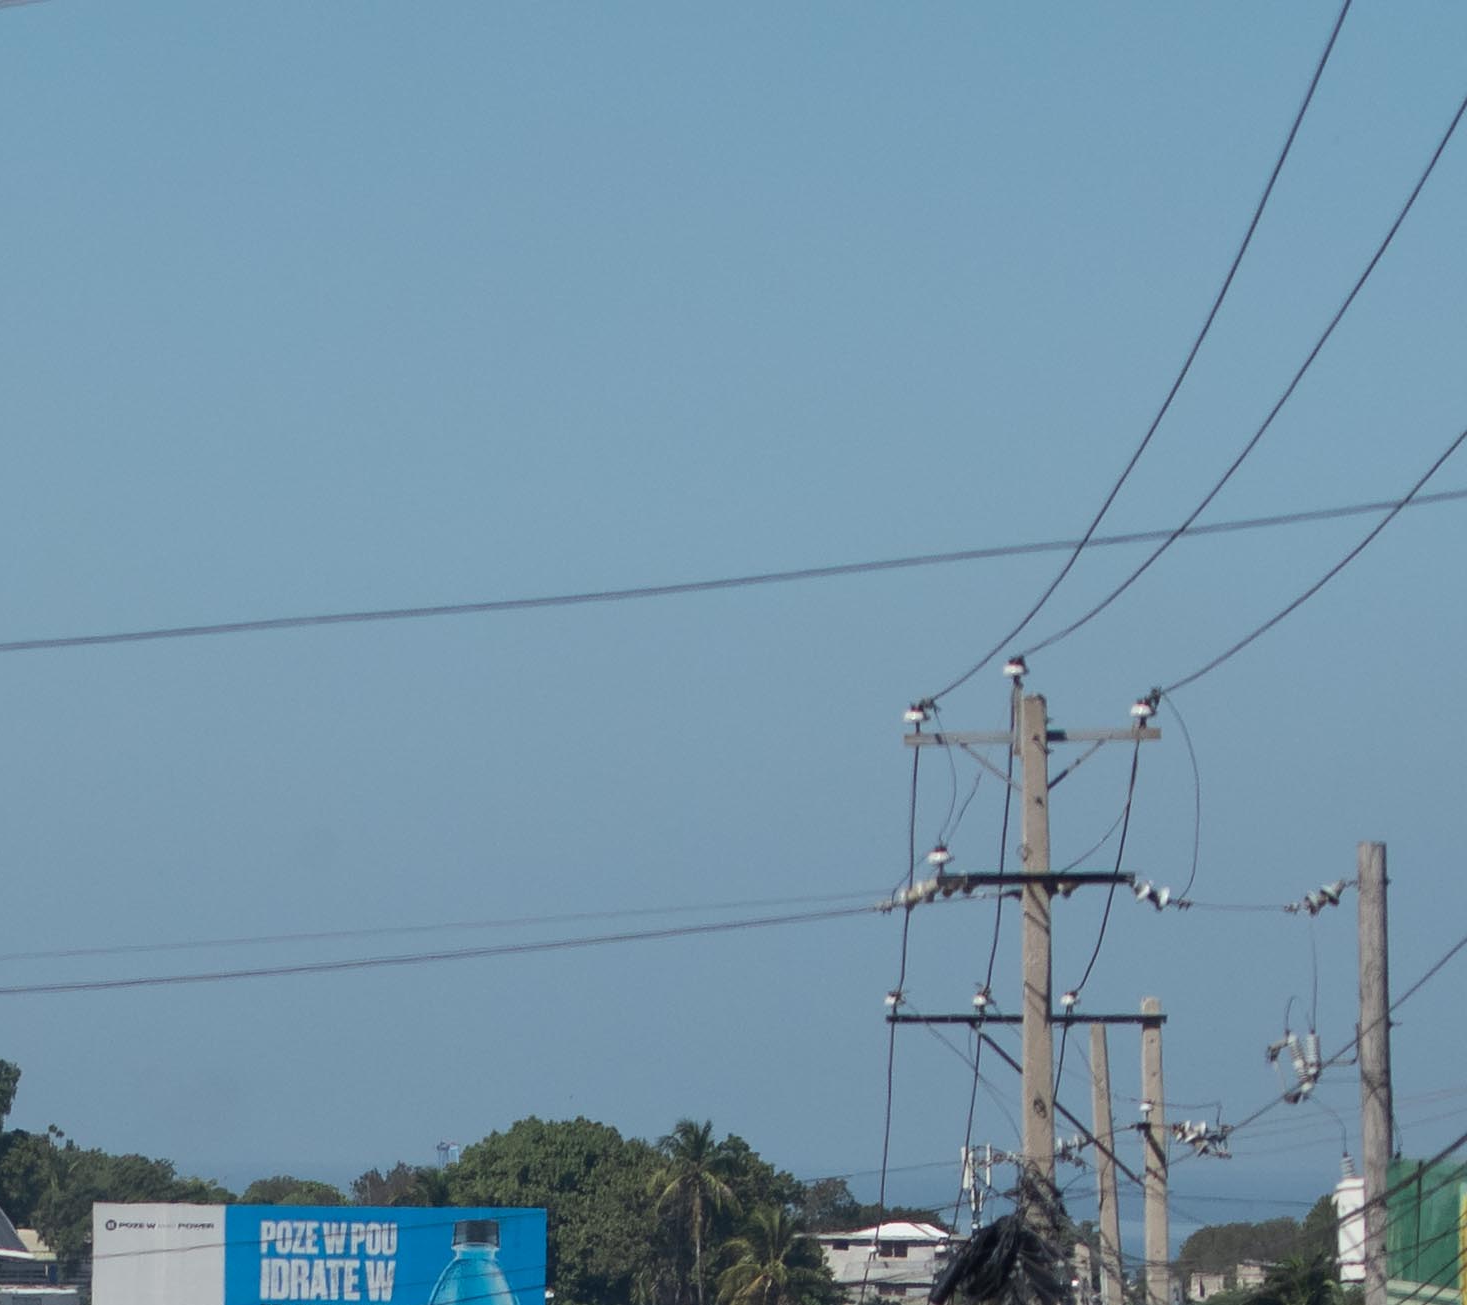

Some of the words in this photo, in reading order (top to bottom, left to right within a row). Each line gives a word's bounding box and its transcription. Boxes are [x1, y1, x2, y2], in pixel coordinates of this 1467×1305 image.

[259, 1219, 320, 1255] POZE
[322, 1221, 348, 1255] W
[350, 1221, 398, 1256] POU
[259, 1258, 361, 1302] IDRATE
[365, 1259, 397, 1302] W
